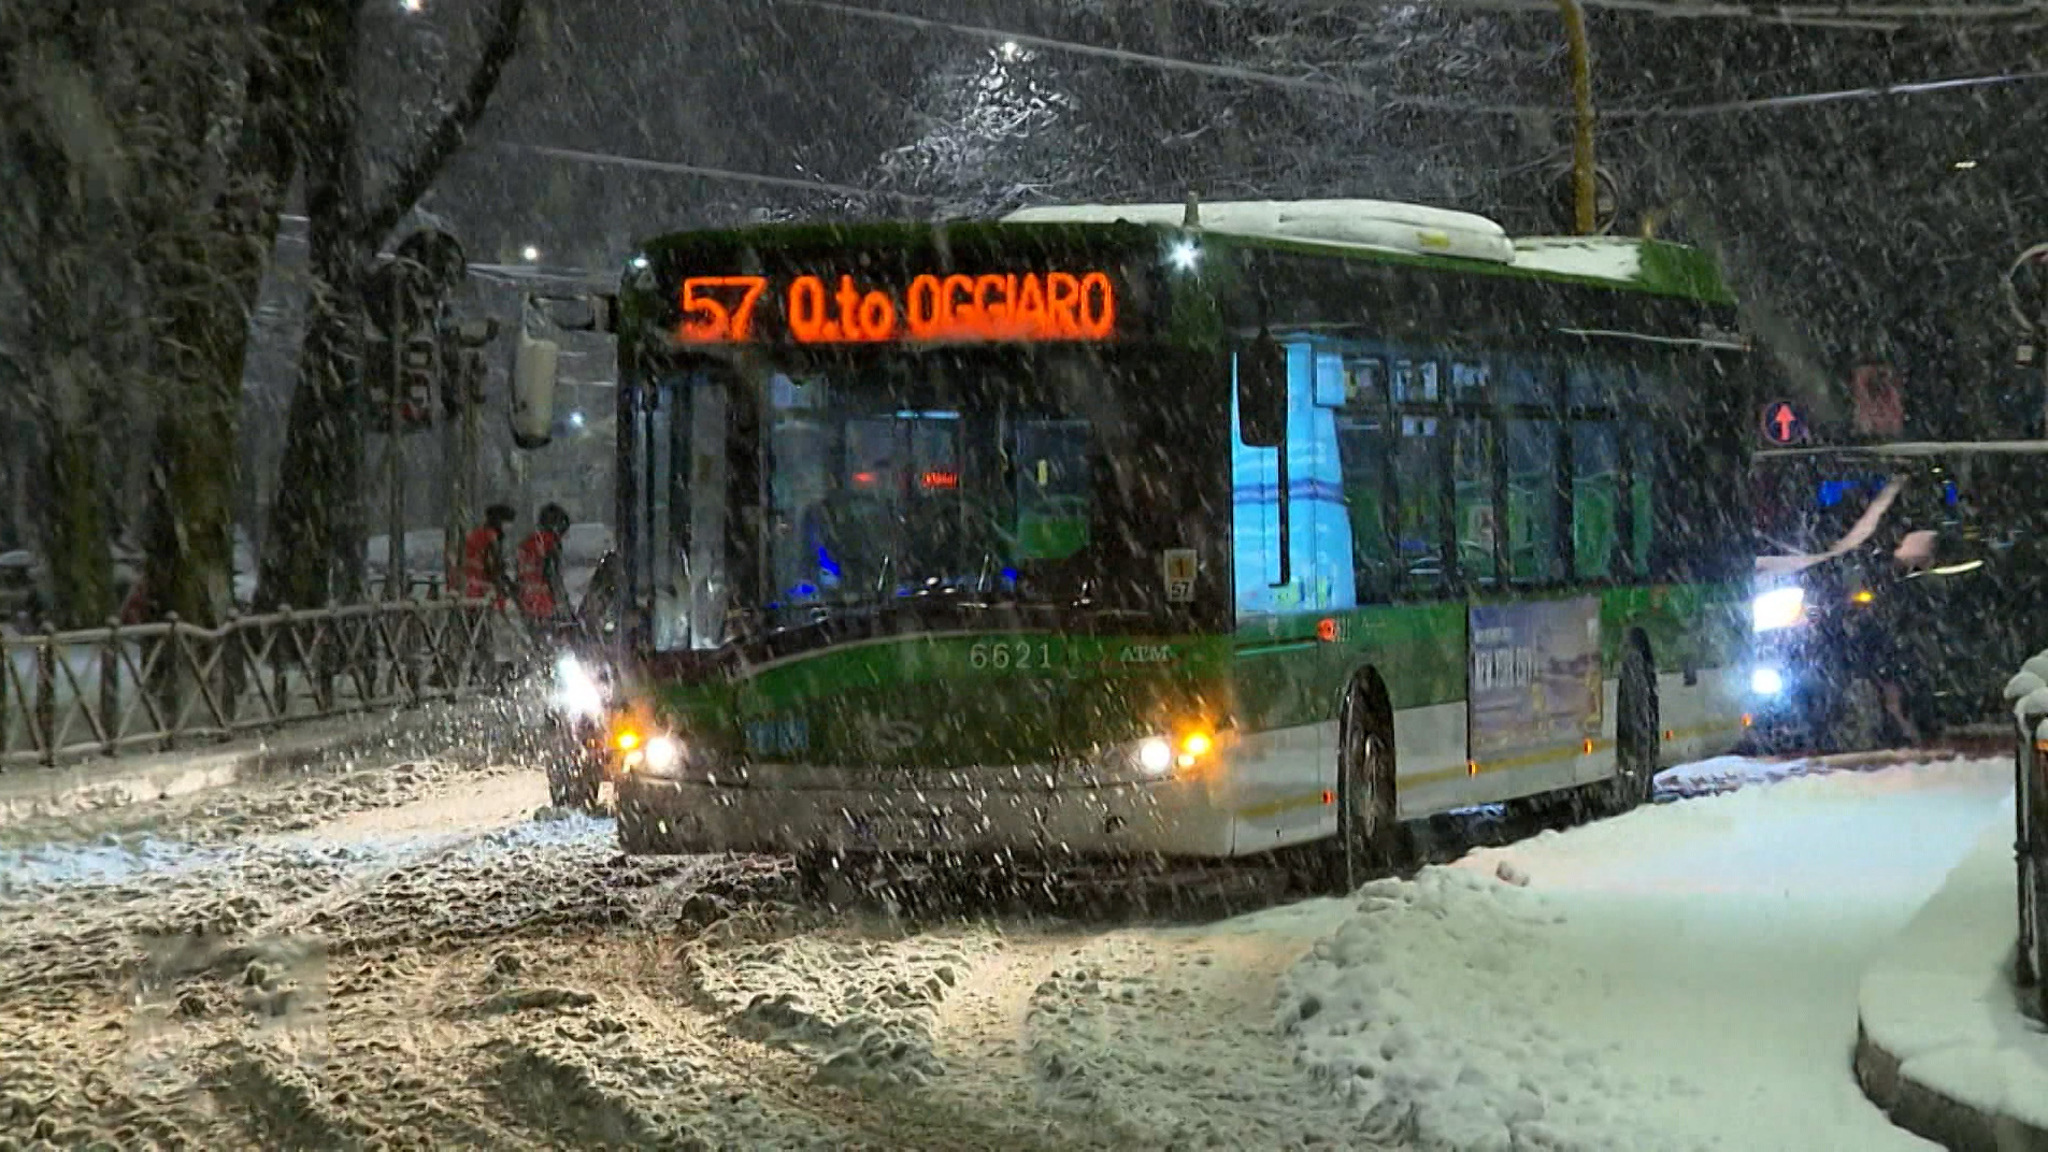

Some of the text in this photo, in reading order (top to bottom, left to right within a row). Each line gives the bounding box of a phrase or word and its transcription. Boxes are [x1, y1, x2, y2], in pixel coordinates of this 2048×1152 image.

[682, 275, 766, 341] 57
[1171, 581, 1190, 598] 57
[969, 642, 1052, 669] 6621
[1119, 645, 1171, 662] ATM
